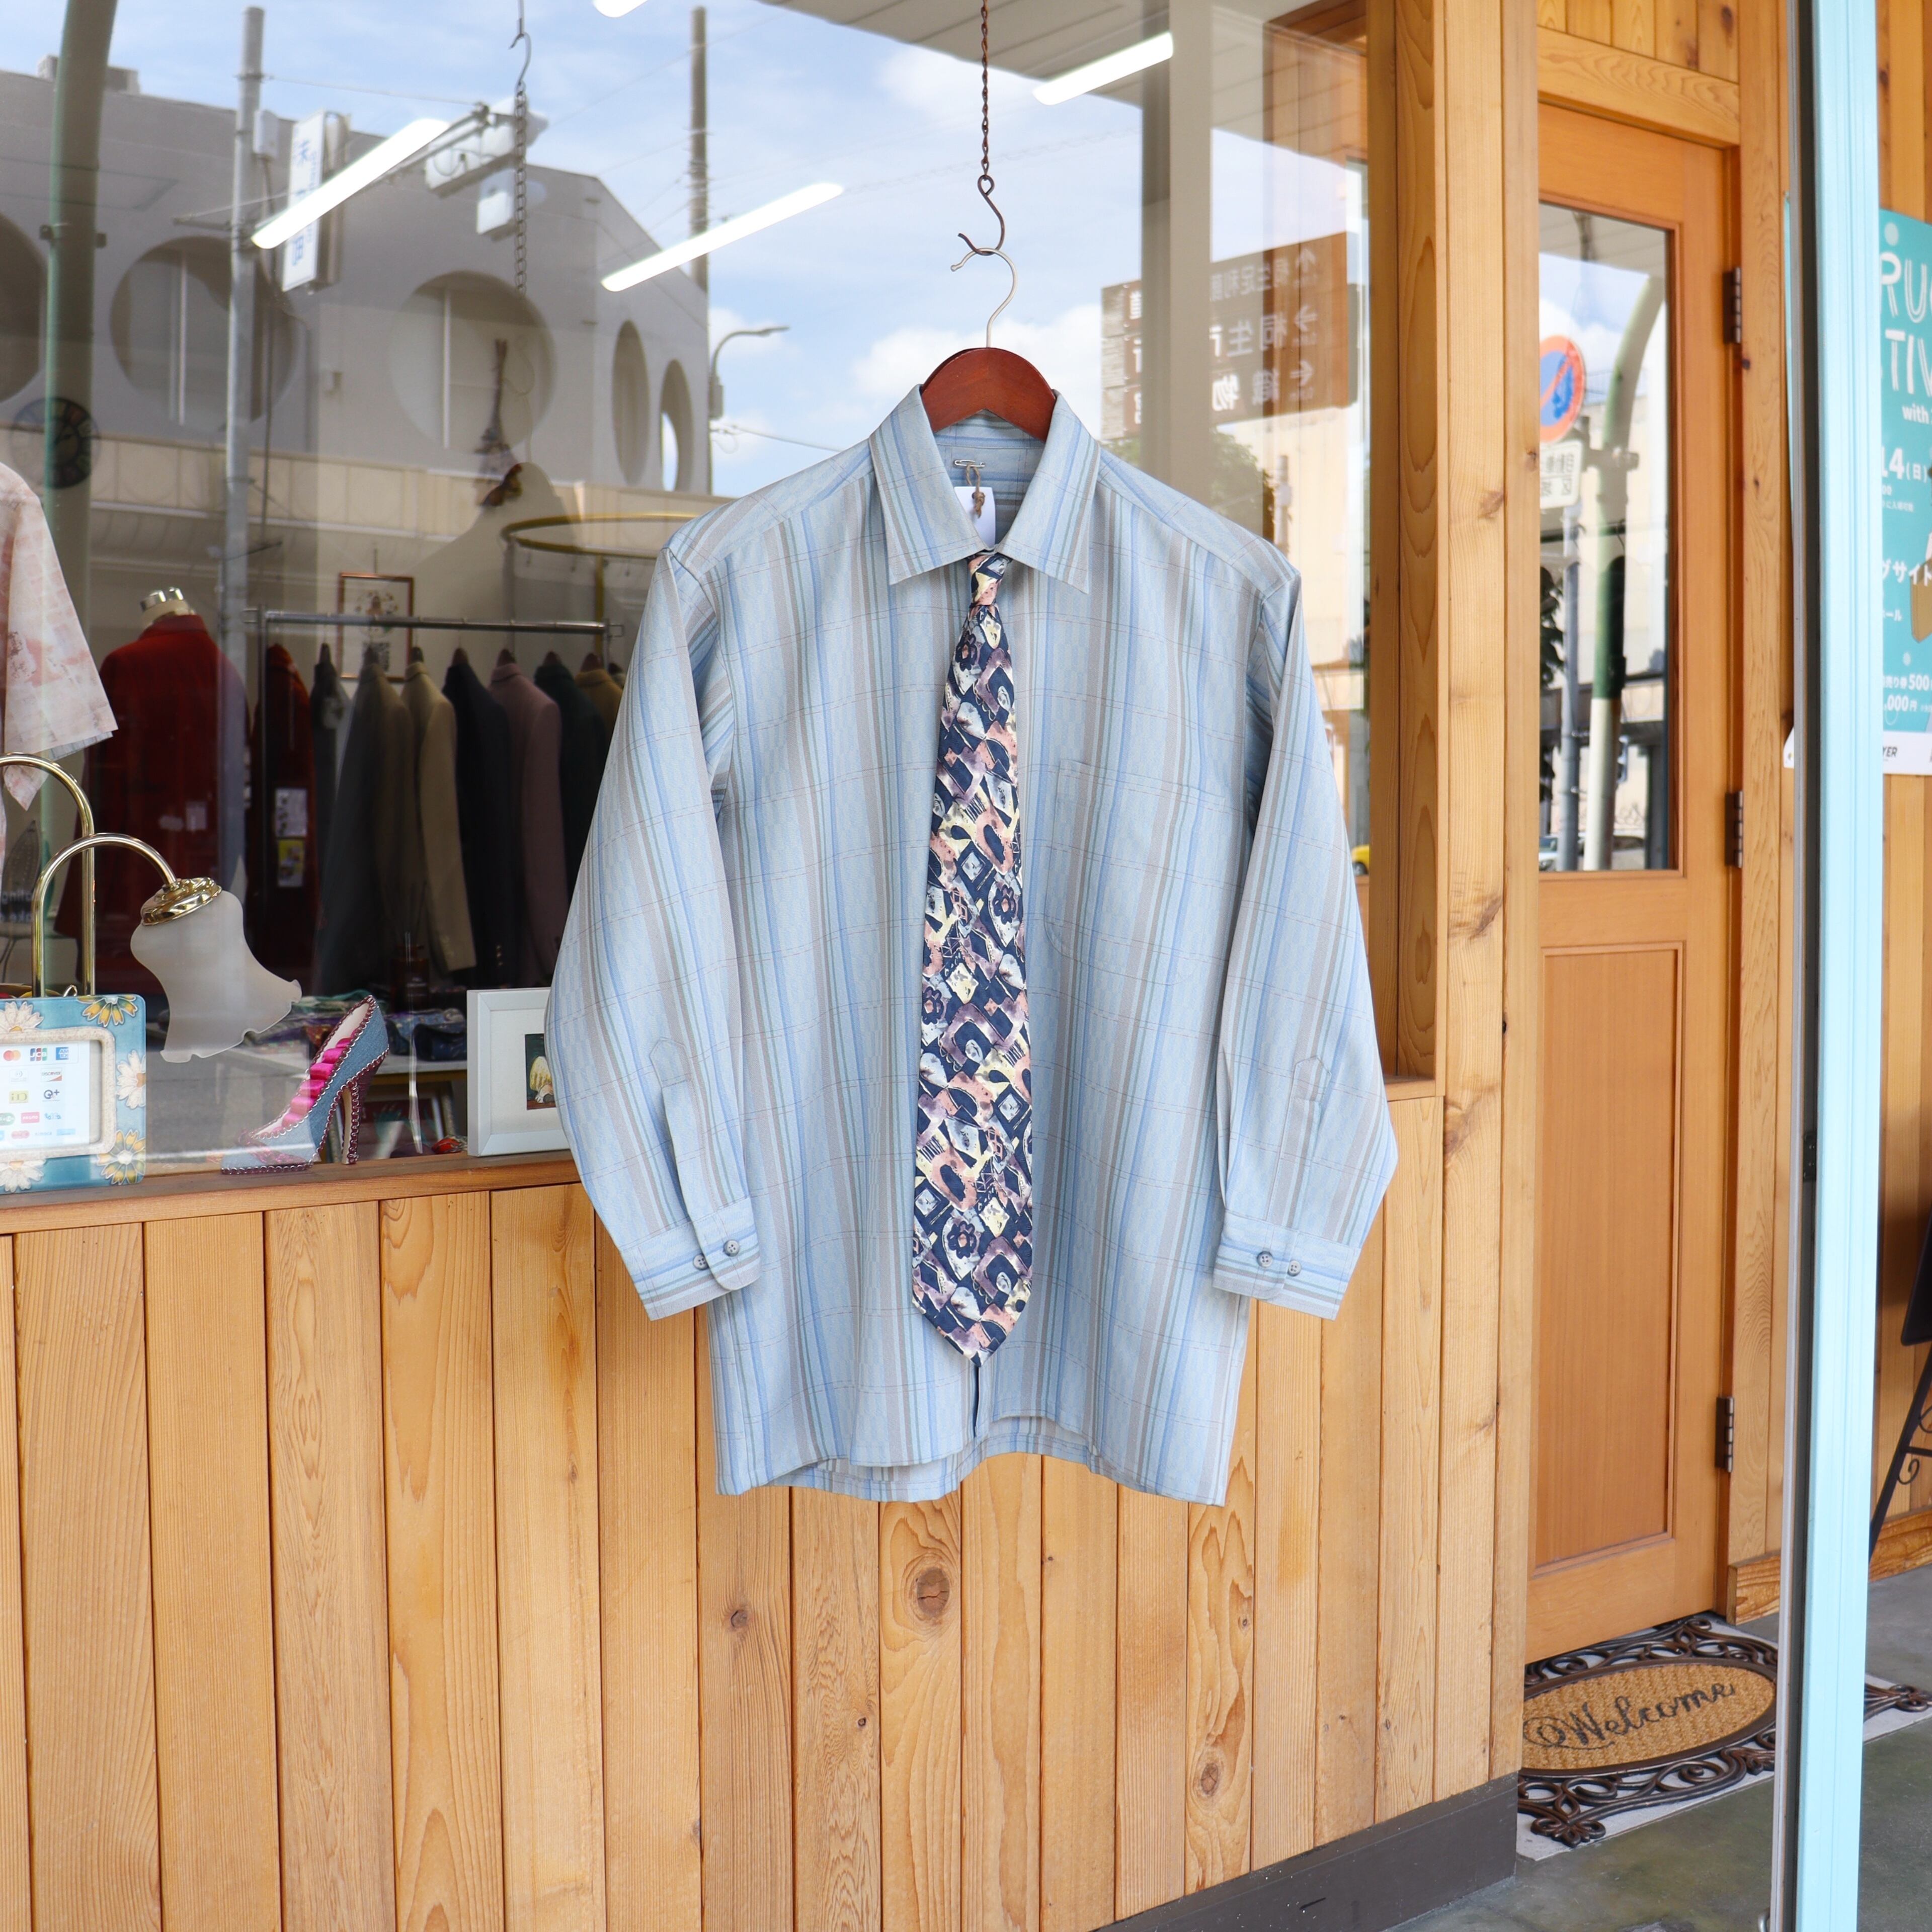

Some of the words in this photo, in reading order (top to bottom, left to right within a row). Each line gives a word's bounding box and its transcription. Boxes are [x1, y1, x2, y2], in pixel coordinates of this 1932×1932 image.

[1880, 252, 1932, 323] RU
[1902, 403, 1928, 425] with
[1523, 1683, 1735, 1750] Welcome
